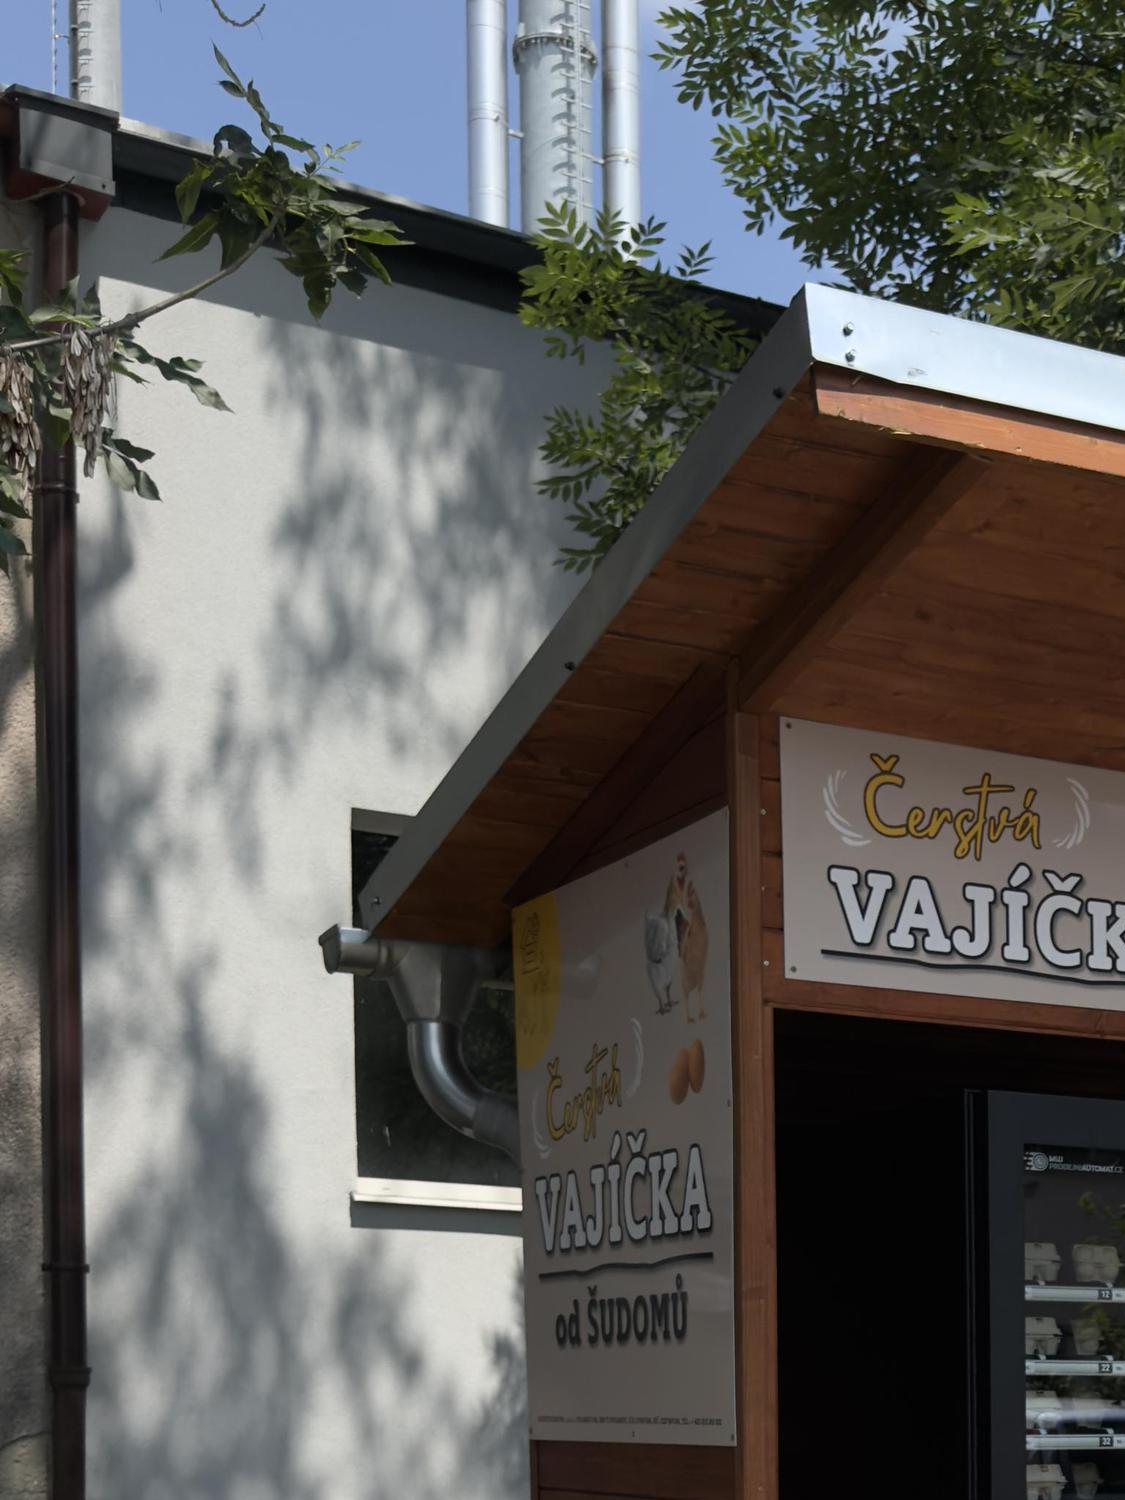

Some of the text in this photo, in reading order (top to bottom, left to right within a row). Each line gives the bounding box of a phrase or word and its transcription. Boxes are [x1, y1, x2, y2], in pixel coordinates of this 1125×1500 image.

[864, 754, 1042, 861] Čerstvá
[546, 1043, 622, 1142] Čerstvá
[535, 1128, 713, 1254] VAJÍČKA
[556, 1273, 688, 1345] od ŠUDOMŮ
